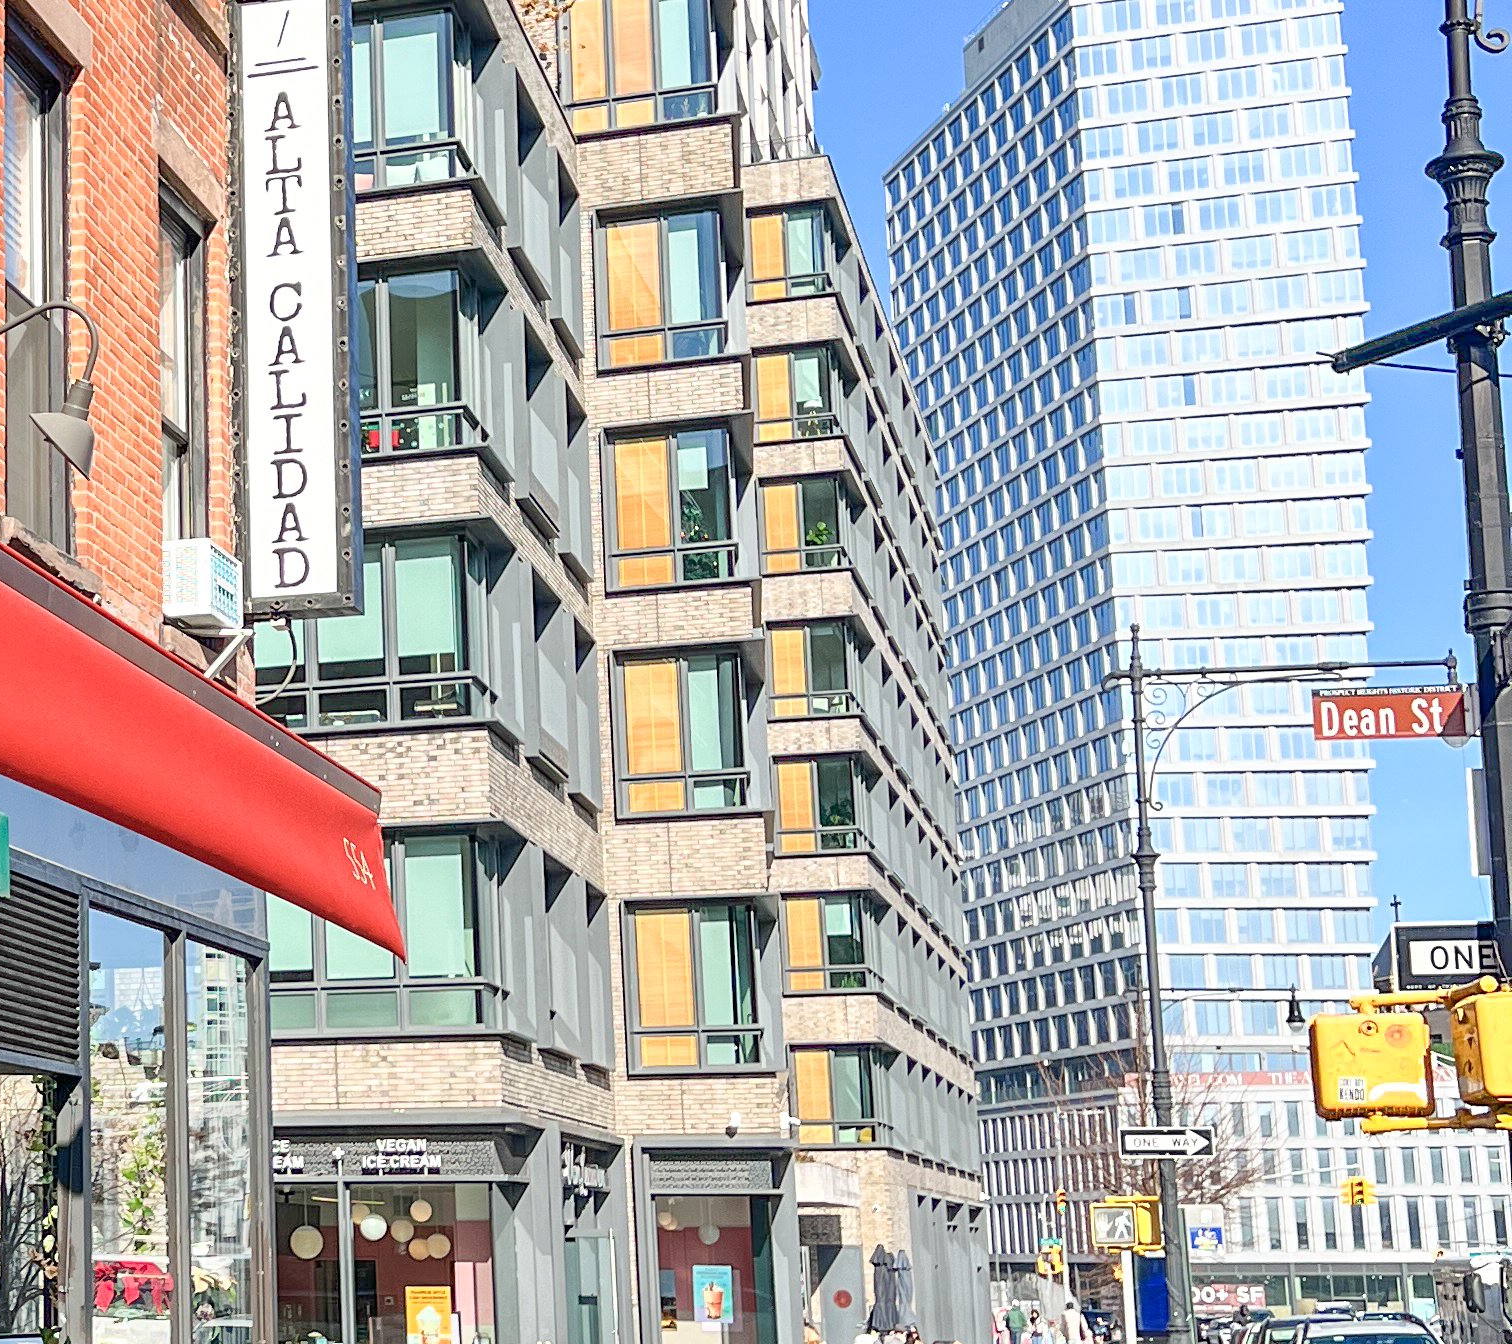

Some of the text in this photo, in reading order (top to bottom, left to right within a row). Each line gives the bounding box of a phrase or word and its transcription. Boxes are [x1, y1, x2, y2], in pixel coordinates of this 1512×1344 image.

[263, 91, 311, 589] ALTA CALIDAD
[1320, 697, 1443, 737] Dean St
[342, 836, 377, 891] 554
[1430, 945, 1498, 970] ONE
[376, 1138, 428, 1152] VEGAN
[1133, 1137, 1199, 1148] ONE WAY
[362, 1155, 442, 1168] ICE CREAM
[1236, 1285, 1264, 1304] SF
